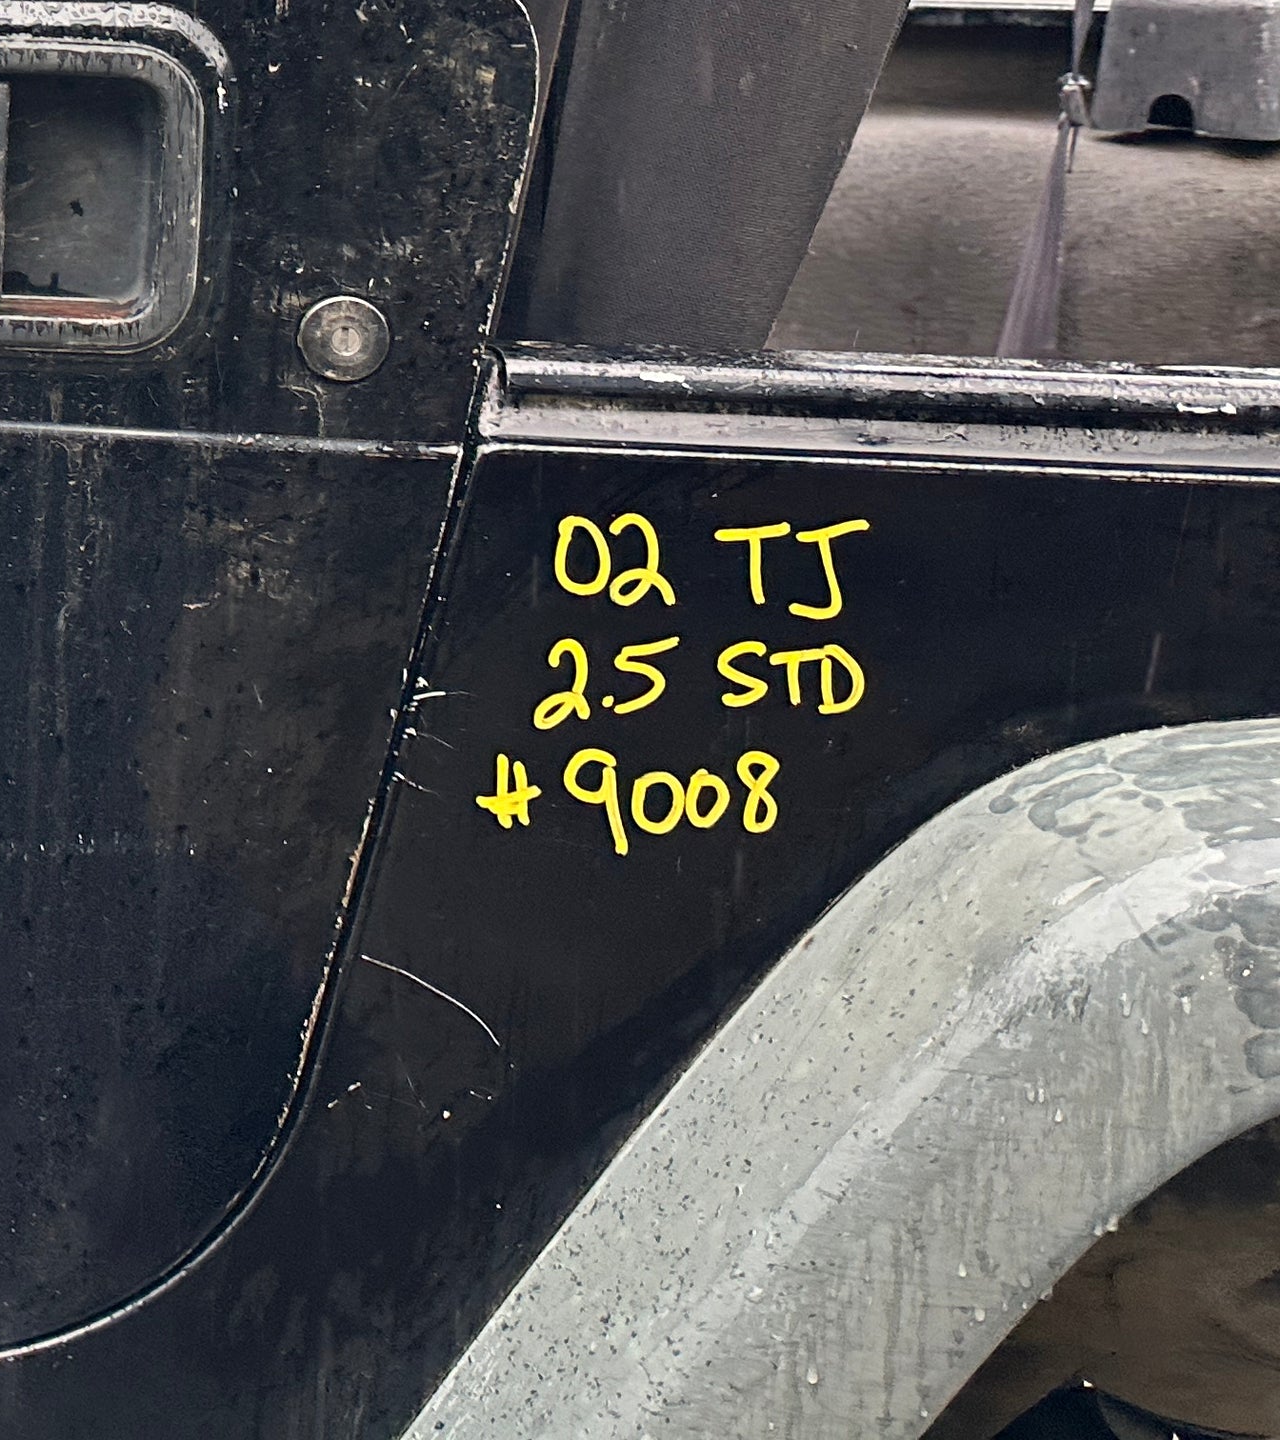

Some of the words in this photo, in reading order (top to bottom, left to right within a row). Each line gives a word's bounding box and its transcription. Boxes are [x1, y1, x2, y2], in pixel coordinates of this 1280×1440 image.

[554, 512, 677, 607] 02
[714, 519, 871, 620] TJ
[532, 636, 680, 730] 2.5
[716, 640, 865, 715] STD
